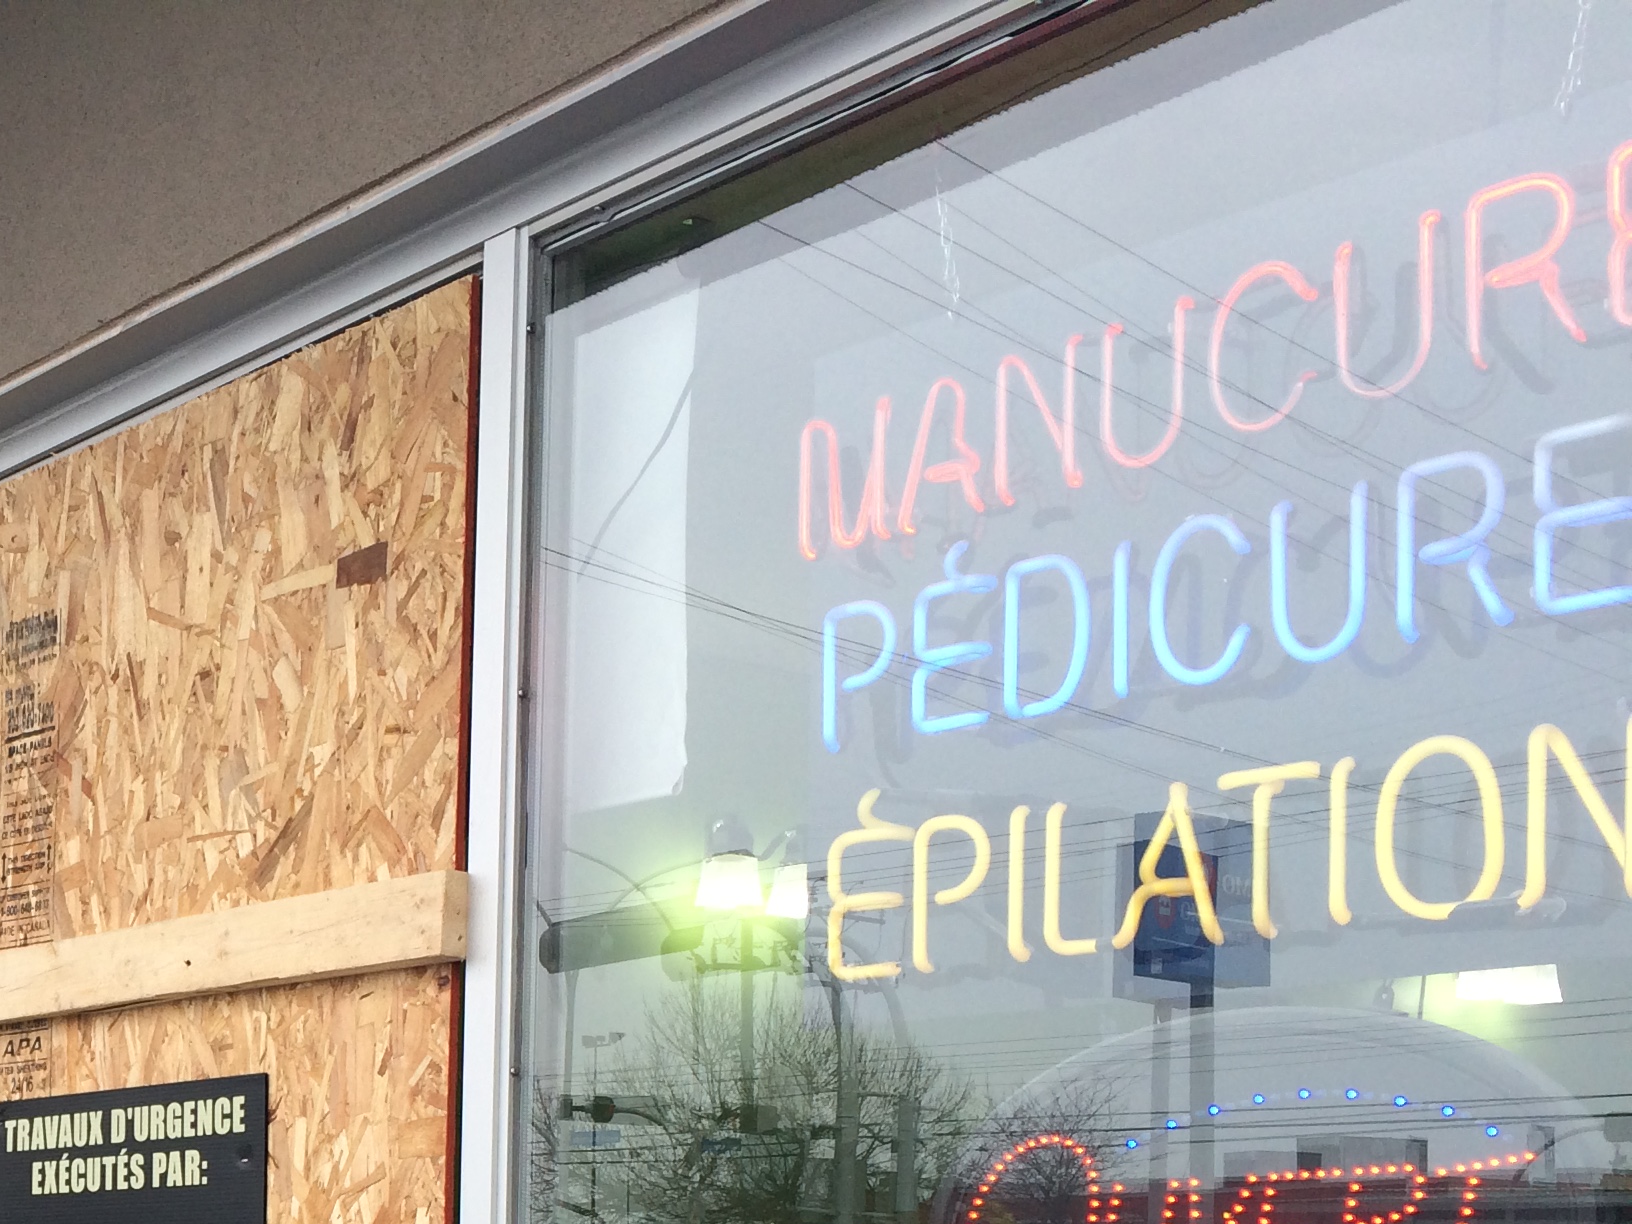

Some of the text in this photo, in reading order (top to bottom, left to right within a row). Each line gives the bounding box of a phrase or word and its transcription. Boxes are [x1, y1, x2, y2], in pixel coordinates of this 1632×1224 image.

[821, 414, 1632, 756] PÉDICURE
[826, 712, 1632, 985] ÉPILATION
[2, 1035, 43, 1058] APA
[5, 1096, 246, 1152] TRAVAUX D'URGENCE
[31, 1148, 208, 1195] EXÉCUTÉS PAR:
